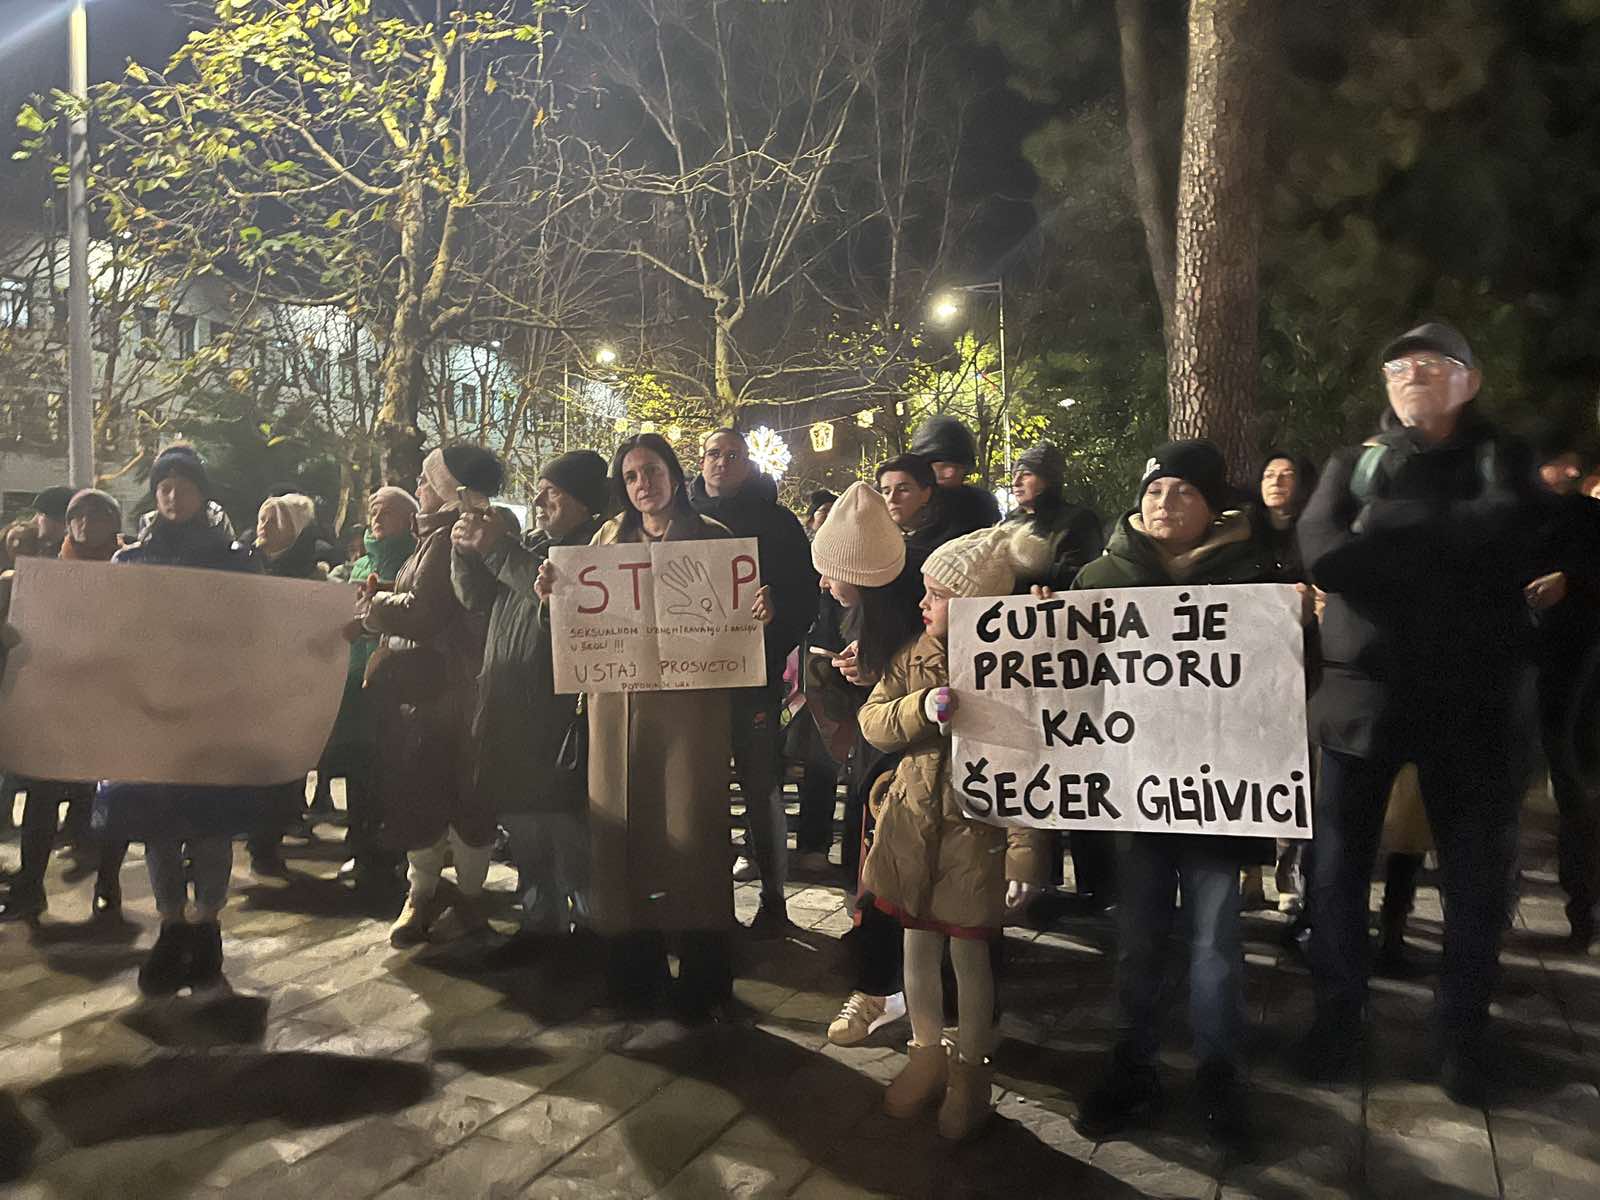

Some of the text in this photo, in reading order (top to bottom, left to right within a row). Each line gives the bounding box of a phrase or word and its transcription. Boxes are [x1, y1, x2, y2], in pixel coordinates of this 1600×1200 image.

[975, 591, 1229, 644] ĆUTNJA JE
[570, 643, 578, 651] U
[574, 655, 746, 684] USTAJ PROSVETO!
[973, 648, 1242, 691] PREDATORU
[1041, 708, 1135, 747] KAO
[961, 757, 1122, 820] ŠEĆER
